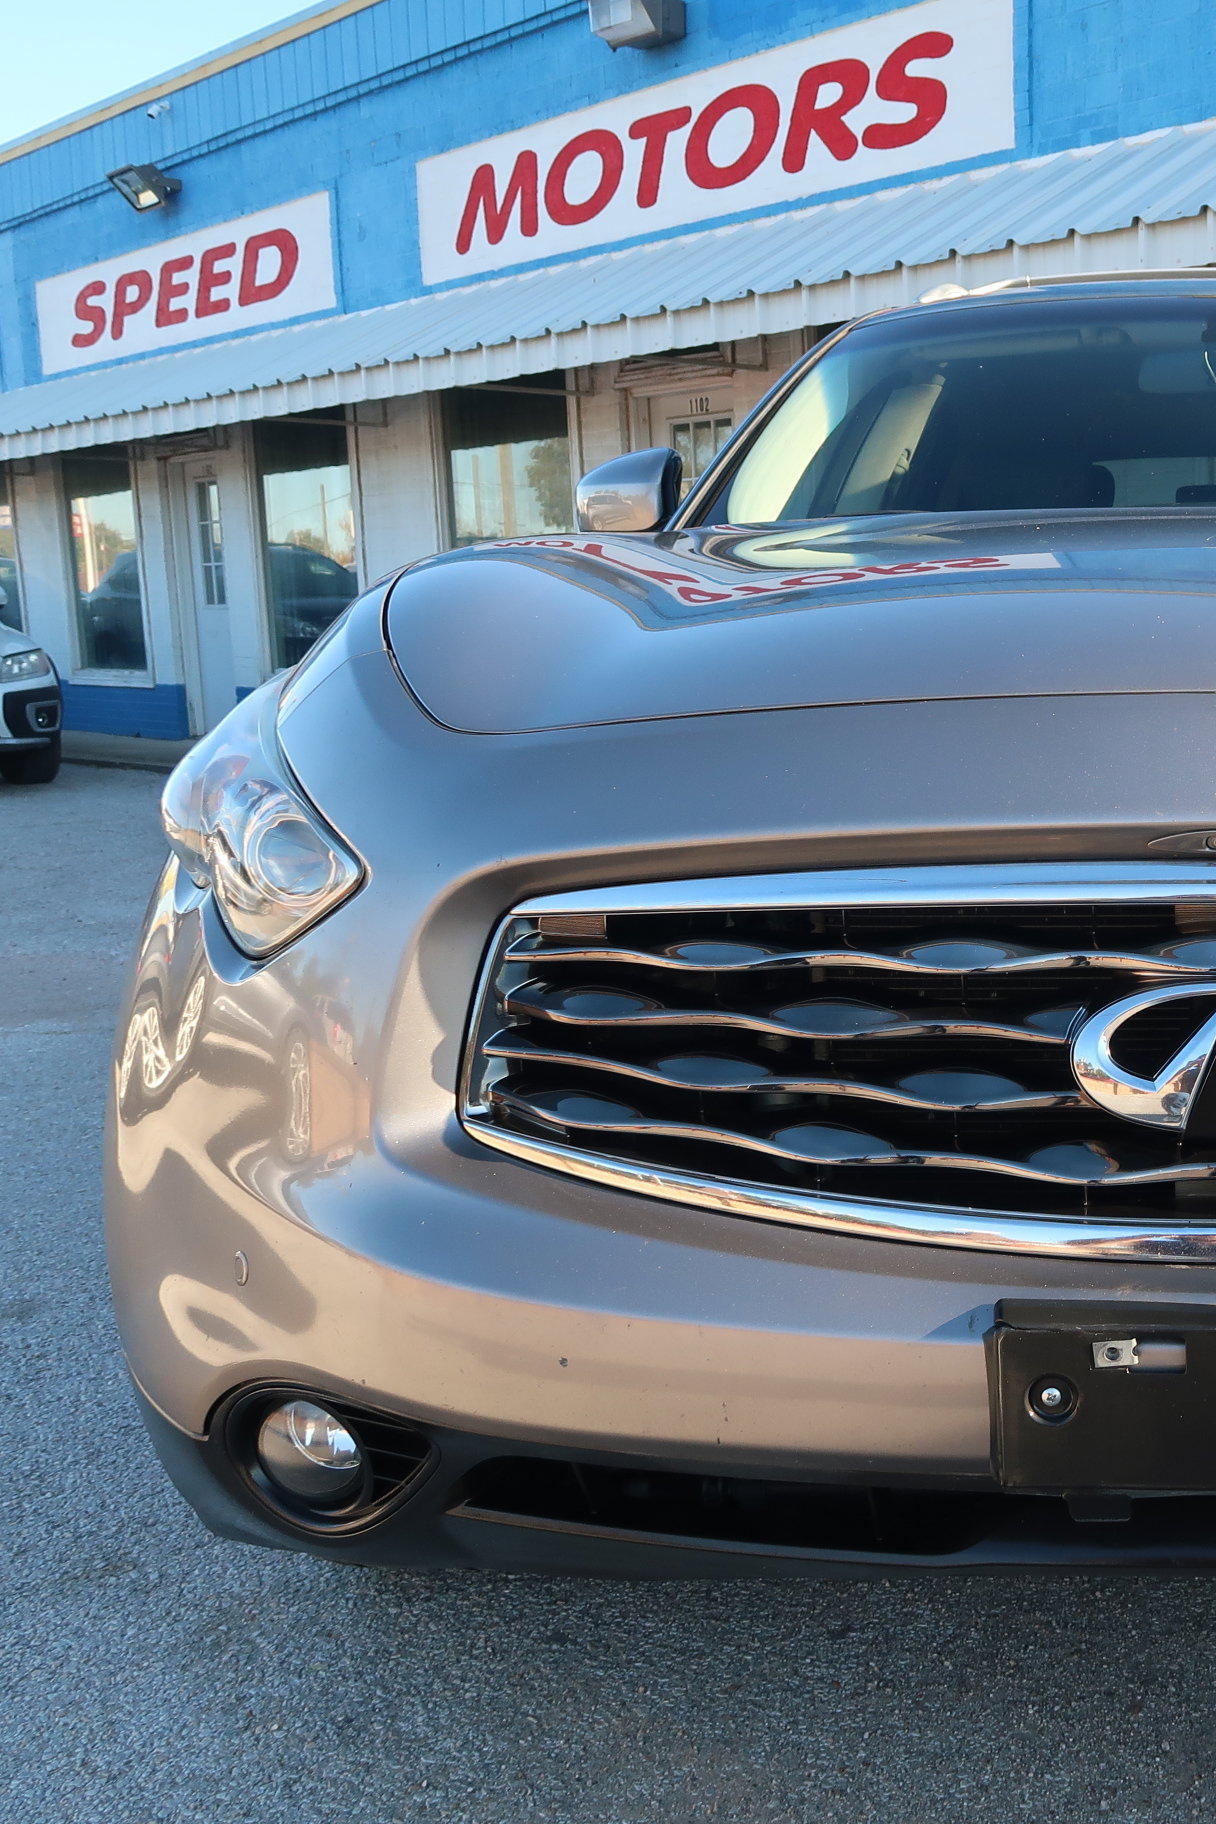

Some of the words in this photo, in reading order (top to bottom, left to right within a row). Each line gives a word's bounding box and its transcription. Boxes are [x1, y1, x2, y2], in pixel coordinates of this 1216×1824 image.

[455, 31, 954, 255] MOTORS
[71, 228, 299, 348] SPEED
[689, 397, 711, 414] 1102
